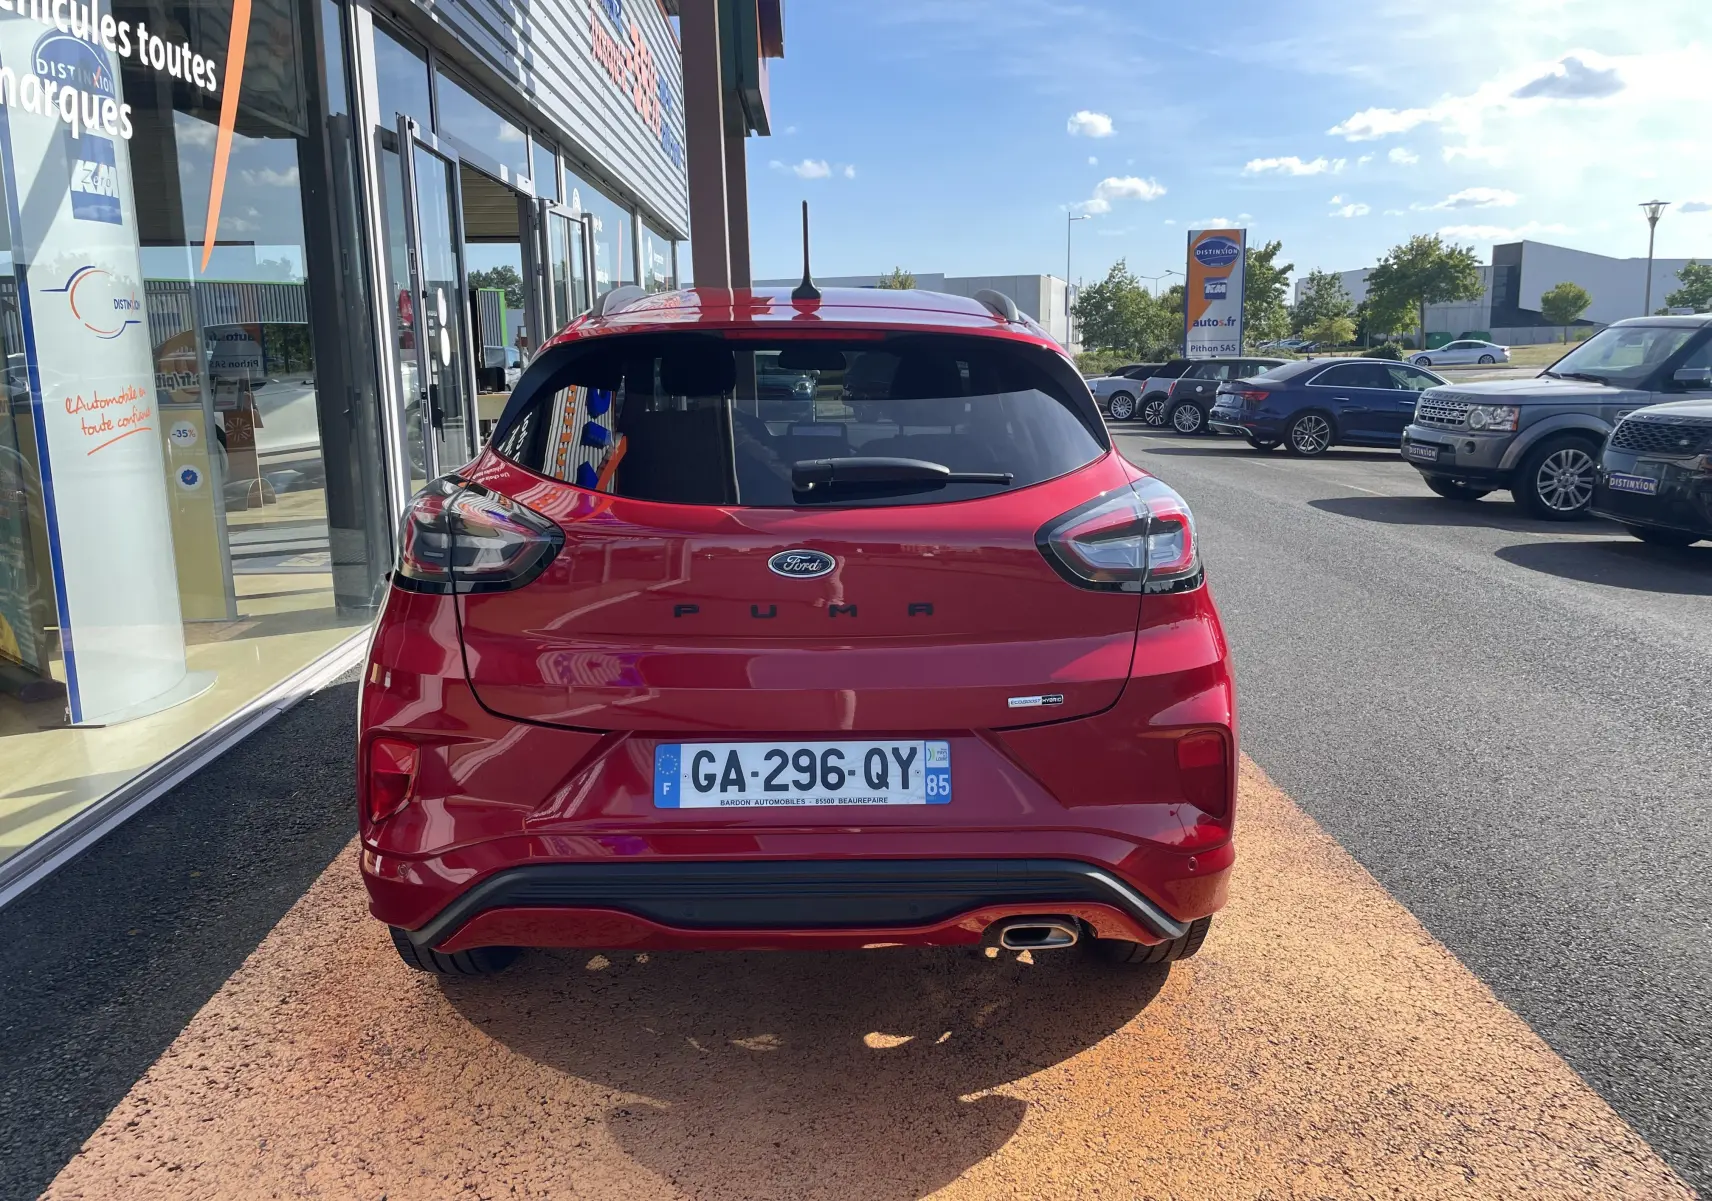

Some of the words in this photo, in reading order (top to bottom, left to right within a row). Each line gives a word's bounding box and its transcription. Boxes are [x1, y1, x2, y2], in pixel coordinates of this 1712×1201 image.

[137, 22, 217, 92] toutes
[36, 59, 115, 93] DISTINXION
[1196, 248, 1238, 256] DISTINXION
[1192, 316, 1237, 328] autos.fr
[1190, 344, 1219, 353] Pithon
[1220, 344, 1236, 352] SAS
[81, 412, 114, 436] toute
[171, 428, 197, 438] -35%
[1610, 477, 1656, 492] DISTINXION
[783, 554, 822, 574] Ford
[673, 603, 934, 619] PUMA
[1042, 696, 1062, 704] HYBRID
[691, 746, 918, 794] GA-296-QY
[662, 782, 672, 795] F
[926, 774, 950, 796] 85
[754, 798, 806, 806] AUTOMOBILES
[838, 796, 888, 805] BEAUREPAIRE
